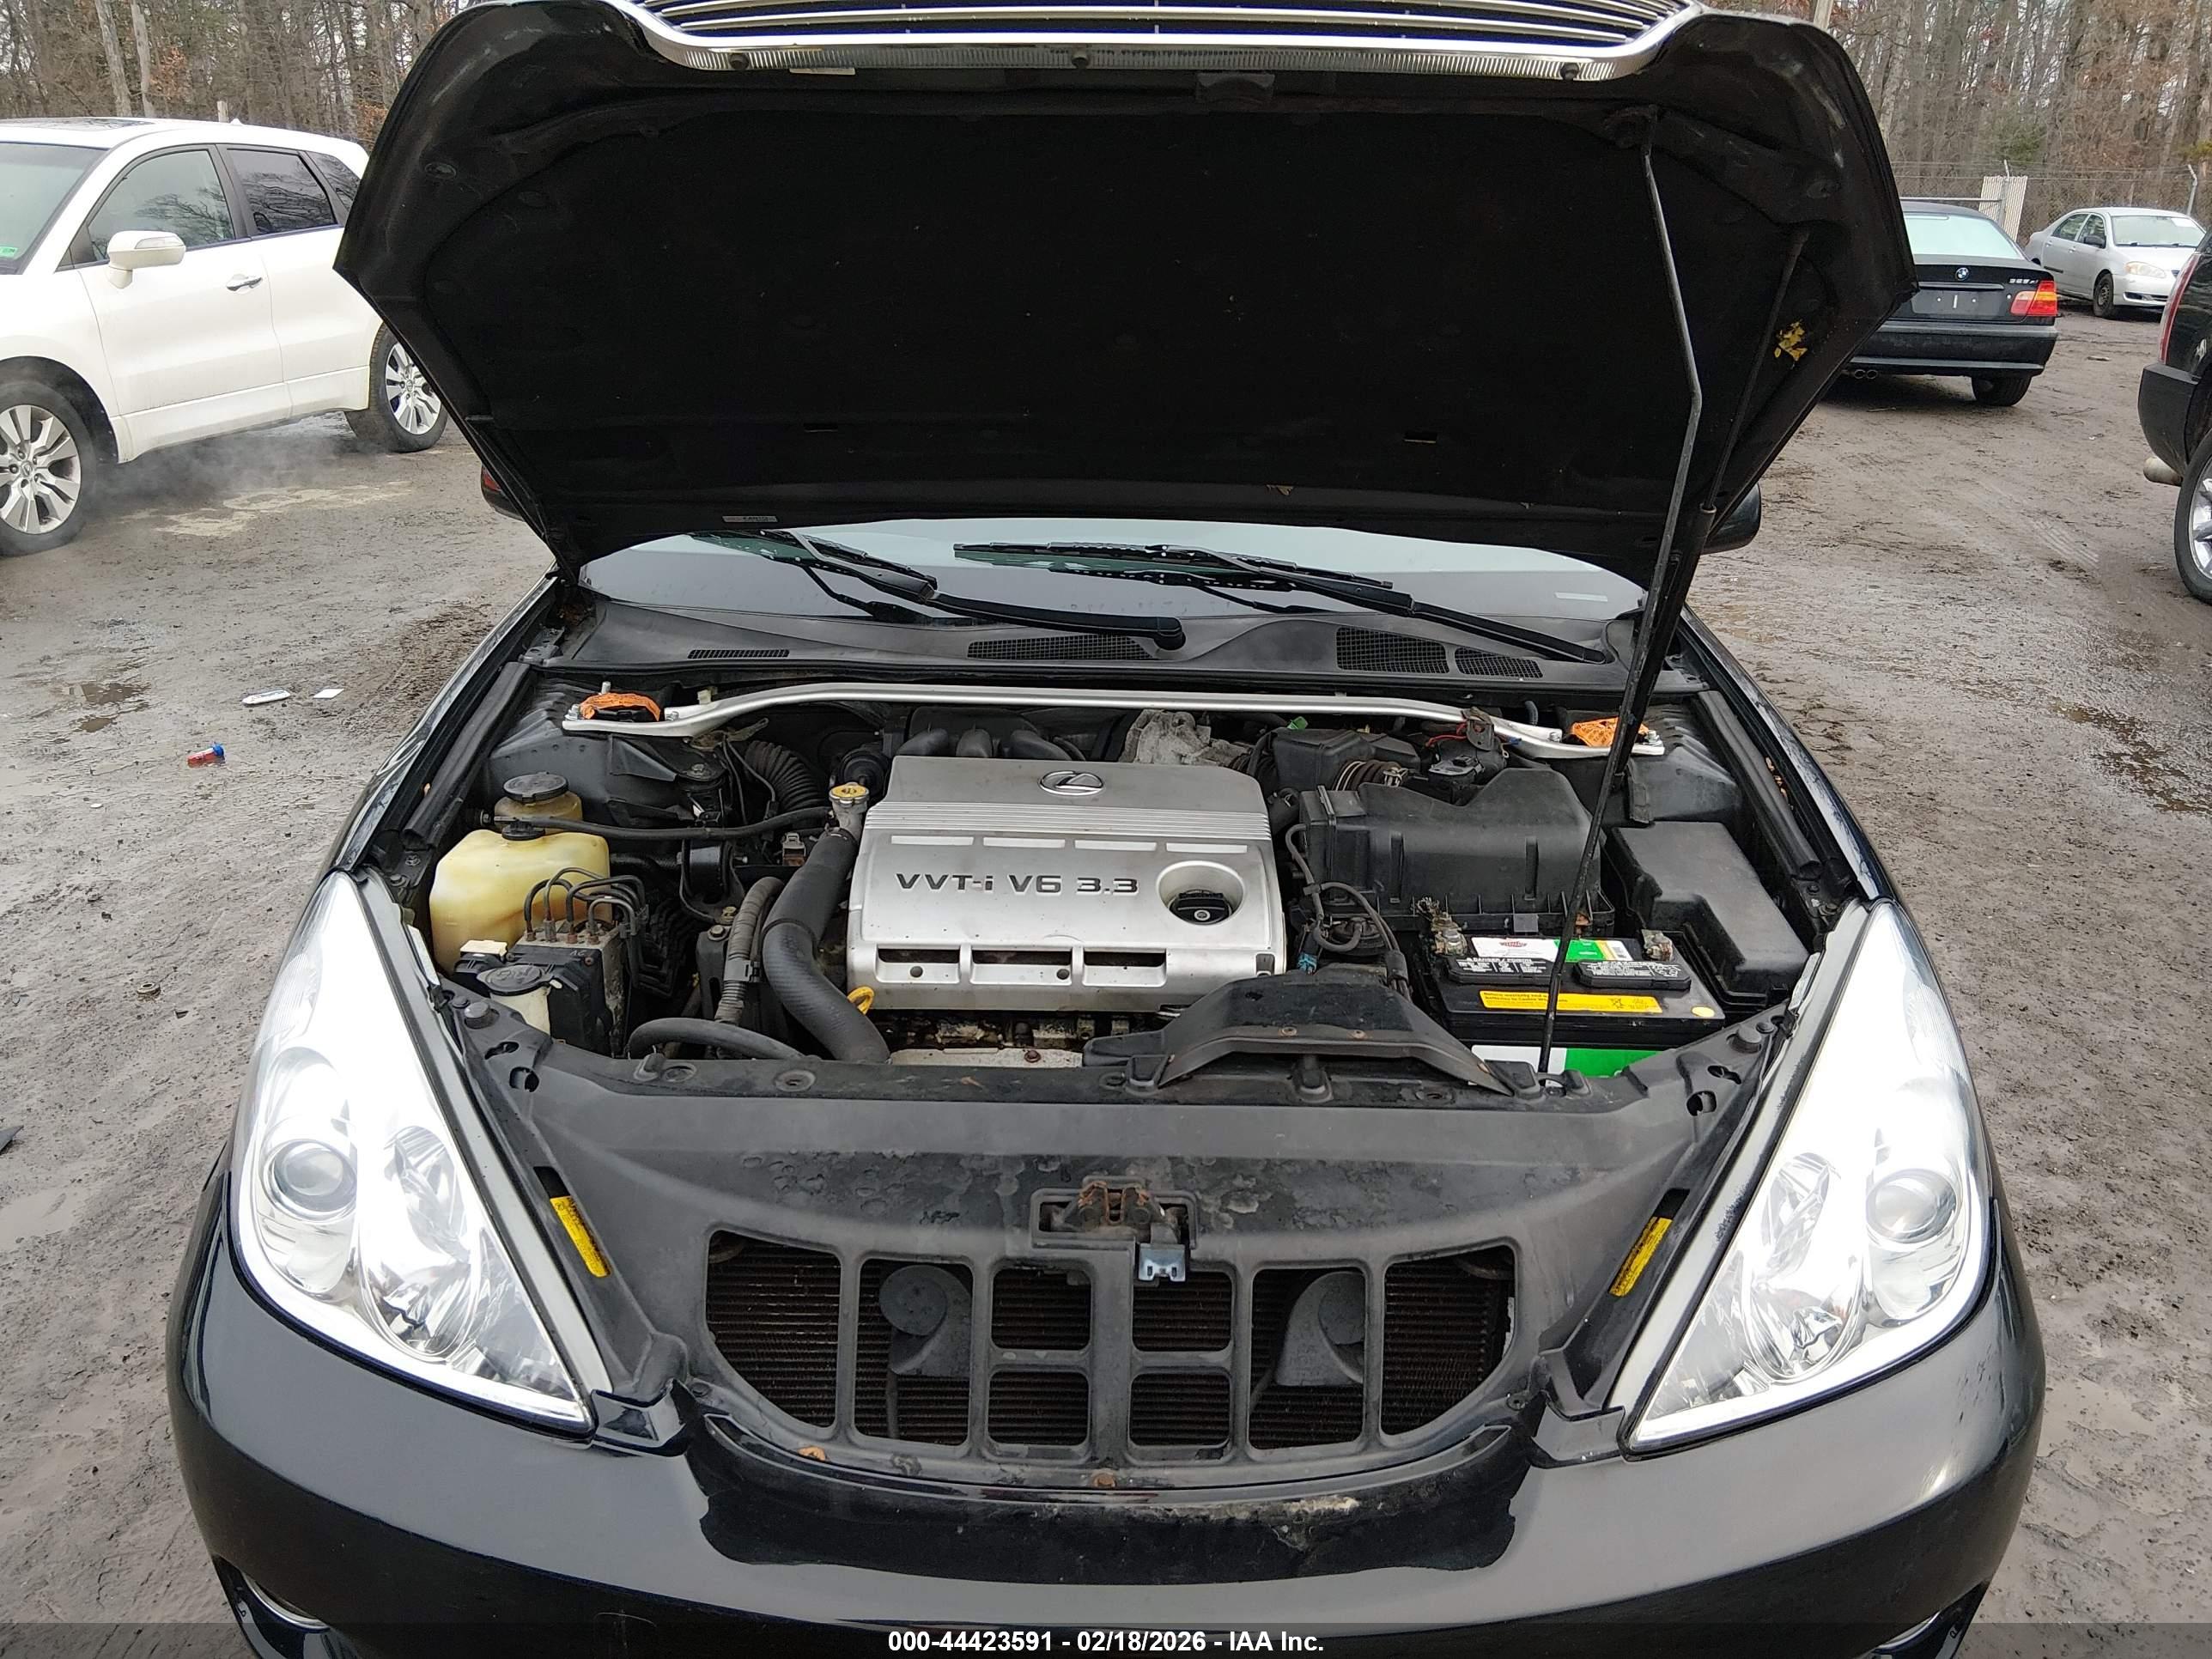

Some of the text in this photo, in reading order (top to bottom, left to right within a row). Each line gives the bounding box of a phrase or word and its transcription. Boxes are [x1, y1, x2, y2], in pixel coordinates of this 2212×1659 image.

[896, 873, 1139, 894] VVT-i V6 3.3
